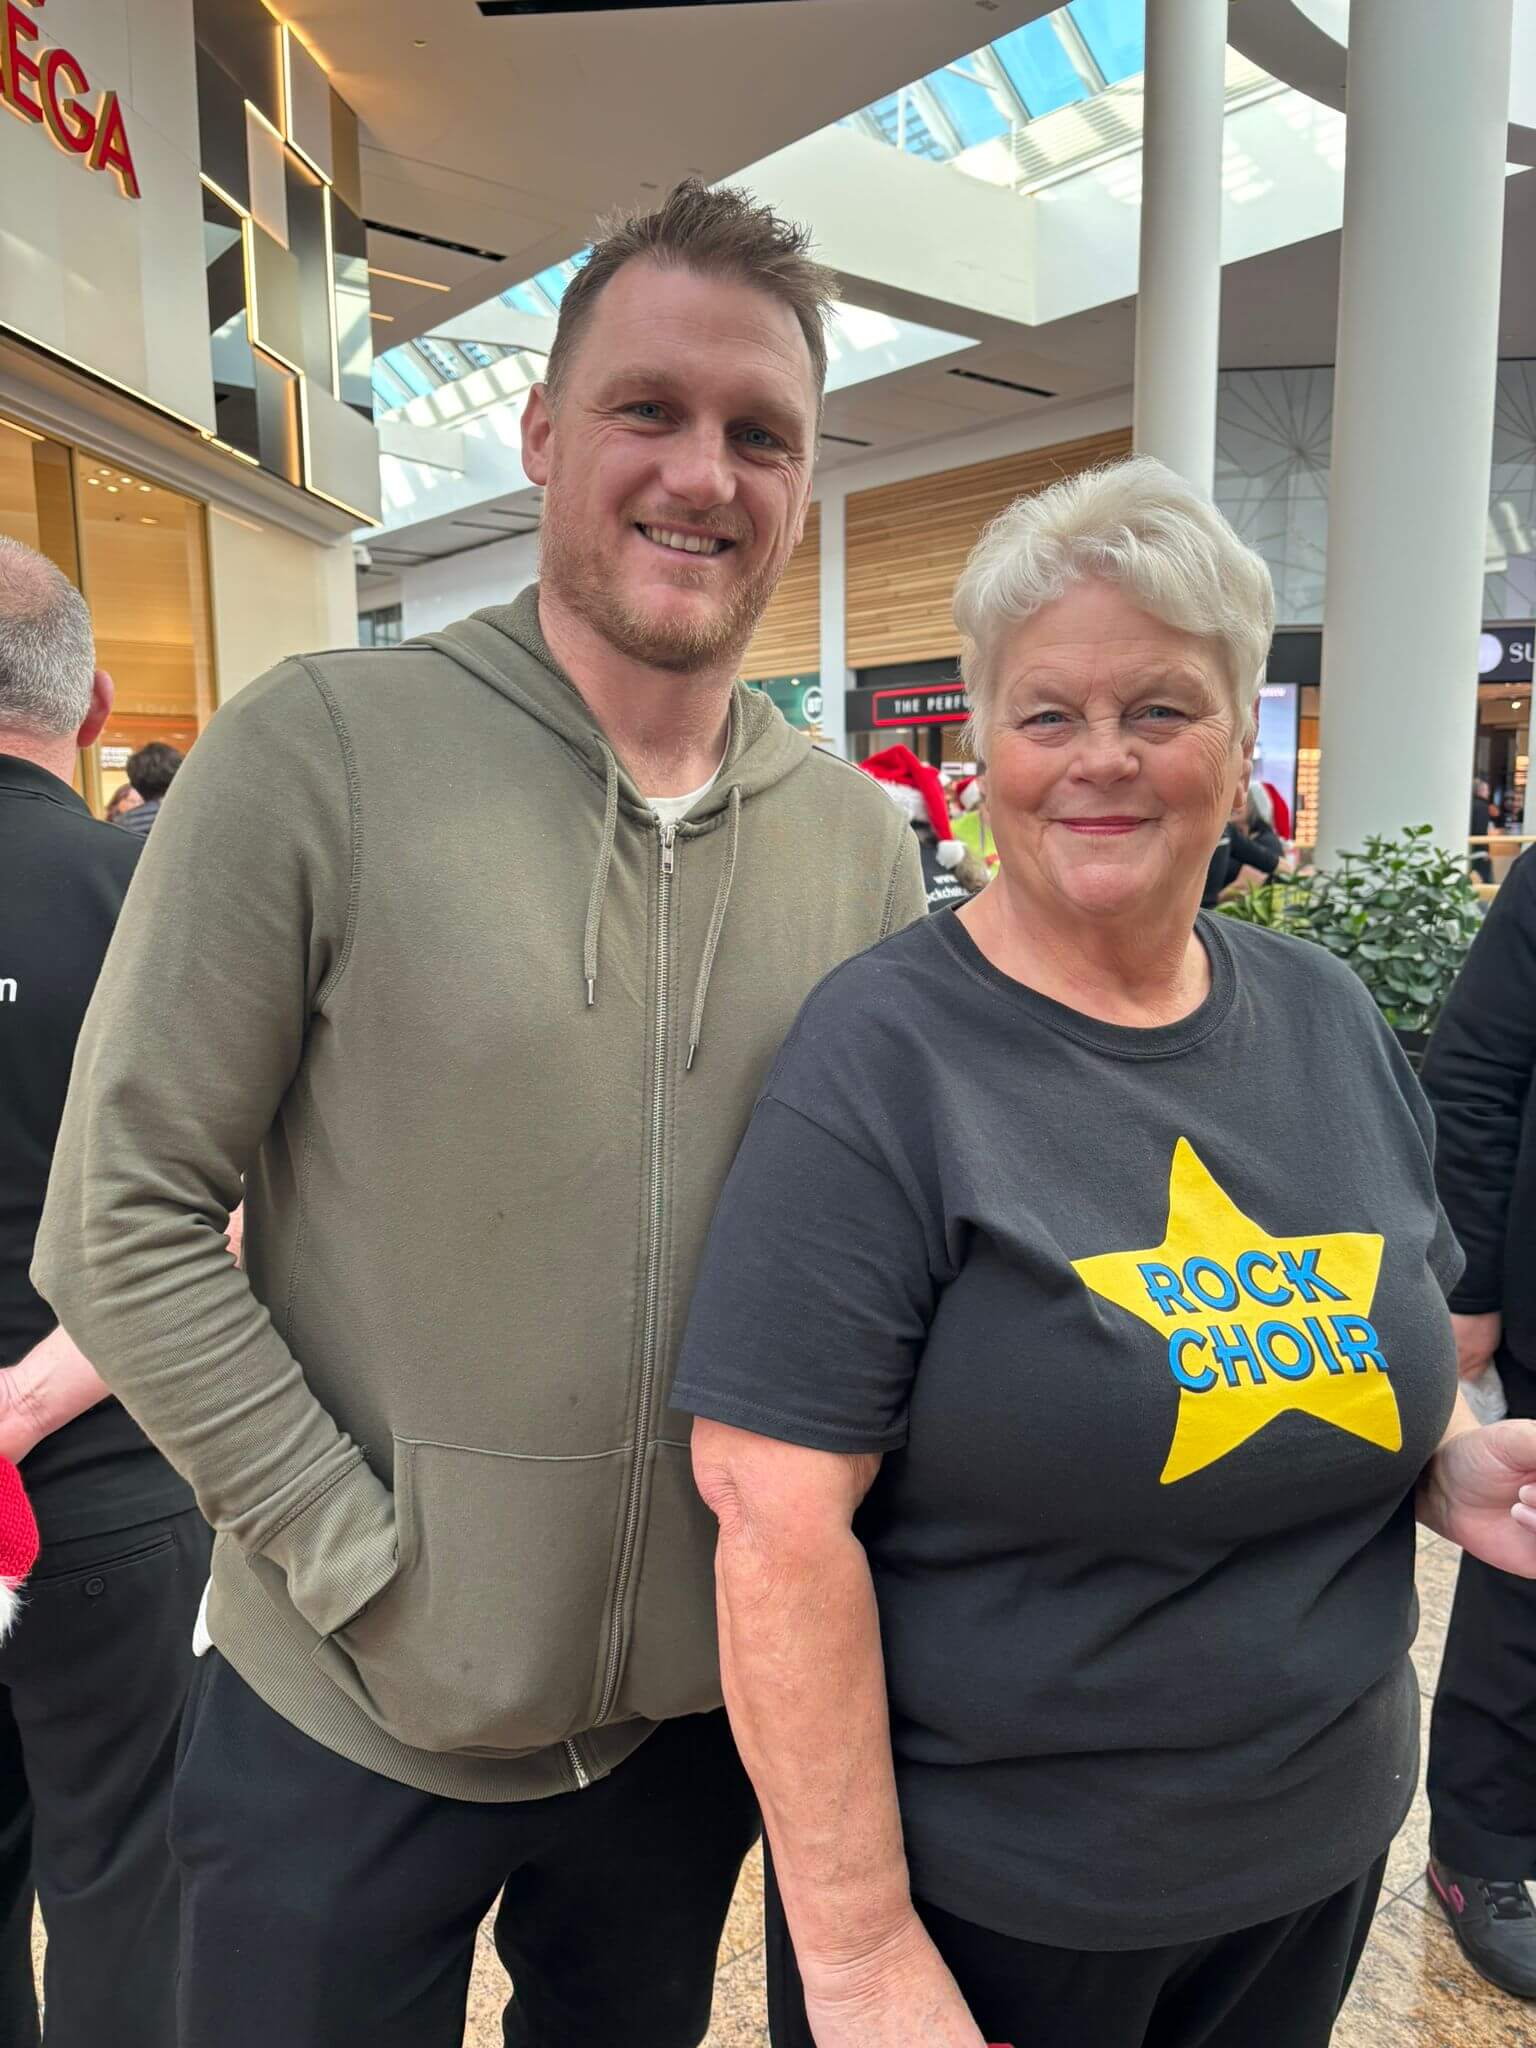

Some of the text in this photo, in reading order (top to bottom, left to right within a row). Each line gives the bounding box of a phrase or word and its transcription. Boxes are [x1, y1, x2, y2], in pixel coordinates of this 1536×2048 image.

[0, 1, 141, 199] EGA
[895, 698, 919, 714] THE
[1137, 1248, 1352, 1316] ROCK
[1168, 1314, 1389, 1393] CHOIR
